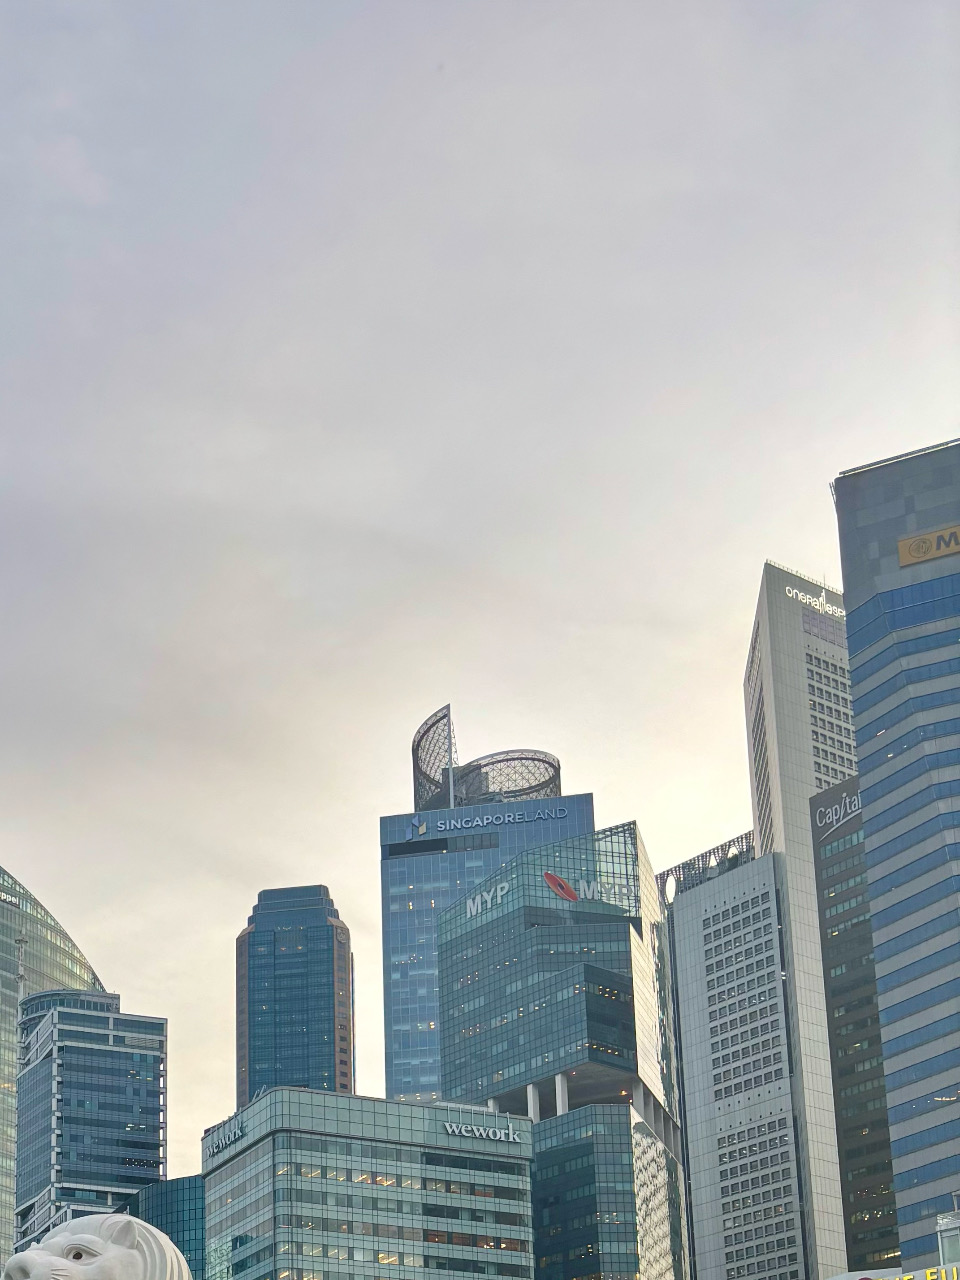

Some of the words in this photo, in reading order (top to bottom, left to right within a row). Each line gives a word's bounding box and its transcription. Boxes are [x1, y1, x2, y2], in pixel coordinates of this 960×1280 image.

[466, 882, 510, 919] MYP
[580, 880, 633, 904] MYP
[206, 1119, 243, 1158] wework
[443, 1122, 522, 1143] wework
